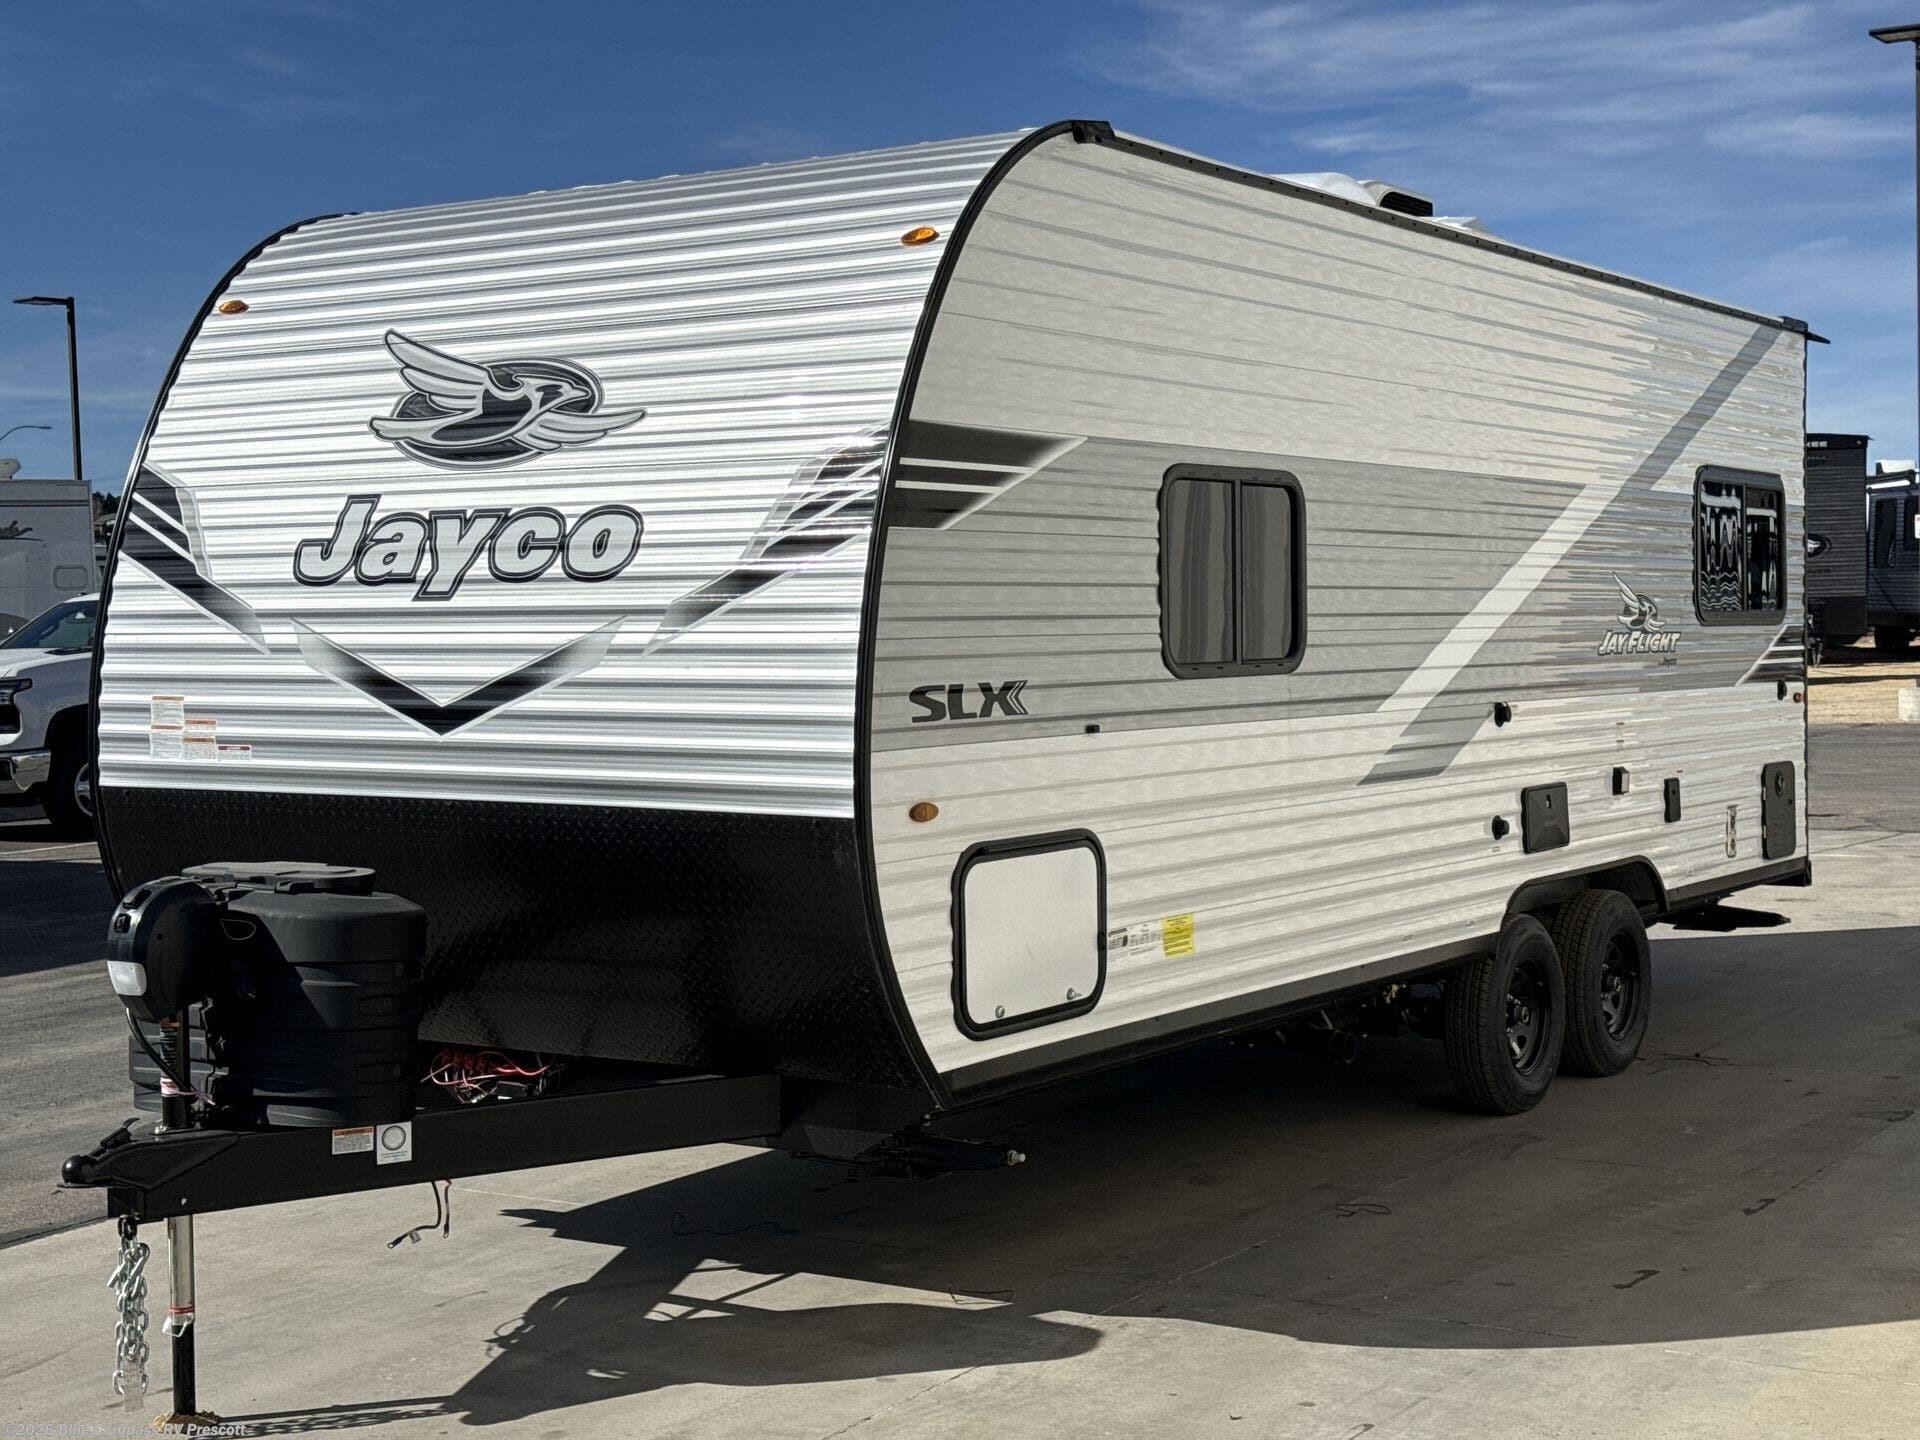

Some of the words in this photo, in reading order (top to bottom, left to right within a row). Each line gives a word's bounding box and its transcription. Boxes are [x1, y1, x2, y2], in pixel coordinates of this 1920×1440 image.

[293, 493, 645, 602] Jayco
[1598, 630, 1629, 656] JAY
[1627, 631, 1682, 653] FLIGHT
[908, 680, 1029, 723] SLX
